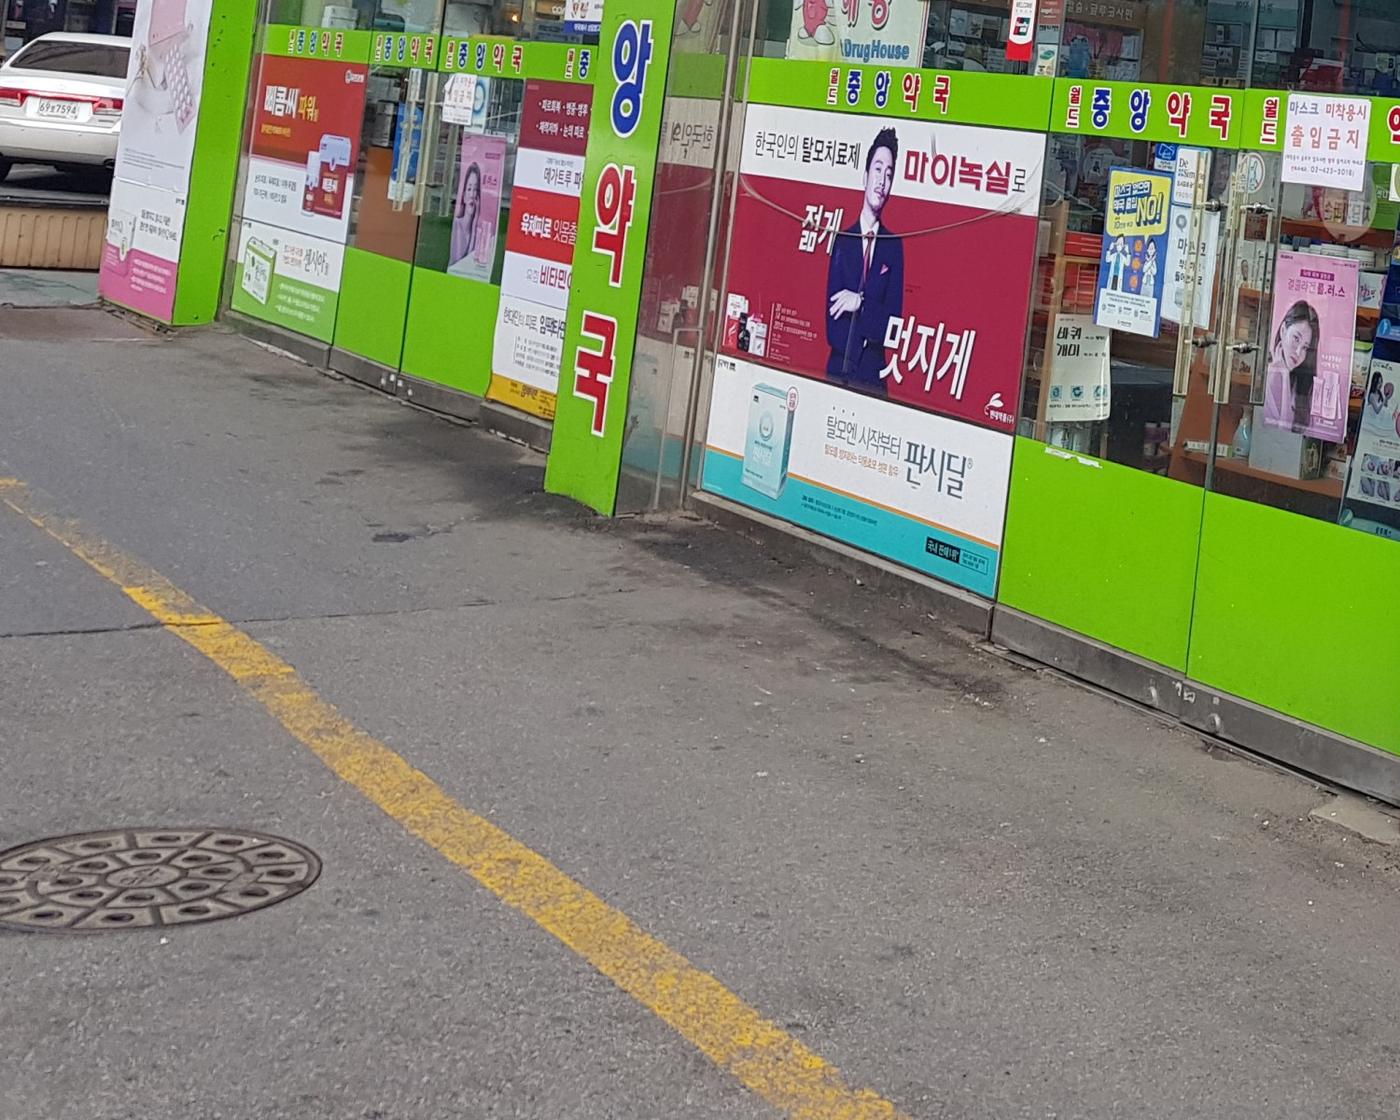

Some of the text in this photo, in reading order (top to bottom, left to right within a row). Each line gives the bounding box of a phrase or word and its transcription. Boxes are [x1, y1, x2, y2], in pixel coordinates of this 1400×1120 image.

[297, 29, 345, 58] 중앙약국
[385, 35, 435, 64] 중앙약국
[457, 42, 524, 73] 중앙약국
[827, 67, 952, 114] 월드 중앙약국
[1066, 85, 1234, 143] 월드 중앙약국
[1260, 96, 1280, 146] 월드
[1289, 100, 1368, 123] 마스크 미착용시
[755, 130, 861, 171] 한국인의 탈모치료제
[1290, 123, 1360, 151] 출입금지
[1136, 191, 1164, 228] NO!
[798, 203, 844, 256] 젊게
[1056, 326, 1082, 341] 바퀴
[1056, 342, 1081, 357] 개미
[878, 315, 977, 400] 멋지게
[826, 414, 859, 447] 탈모엔
[859, 425, 902, 461] 시작부터
